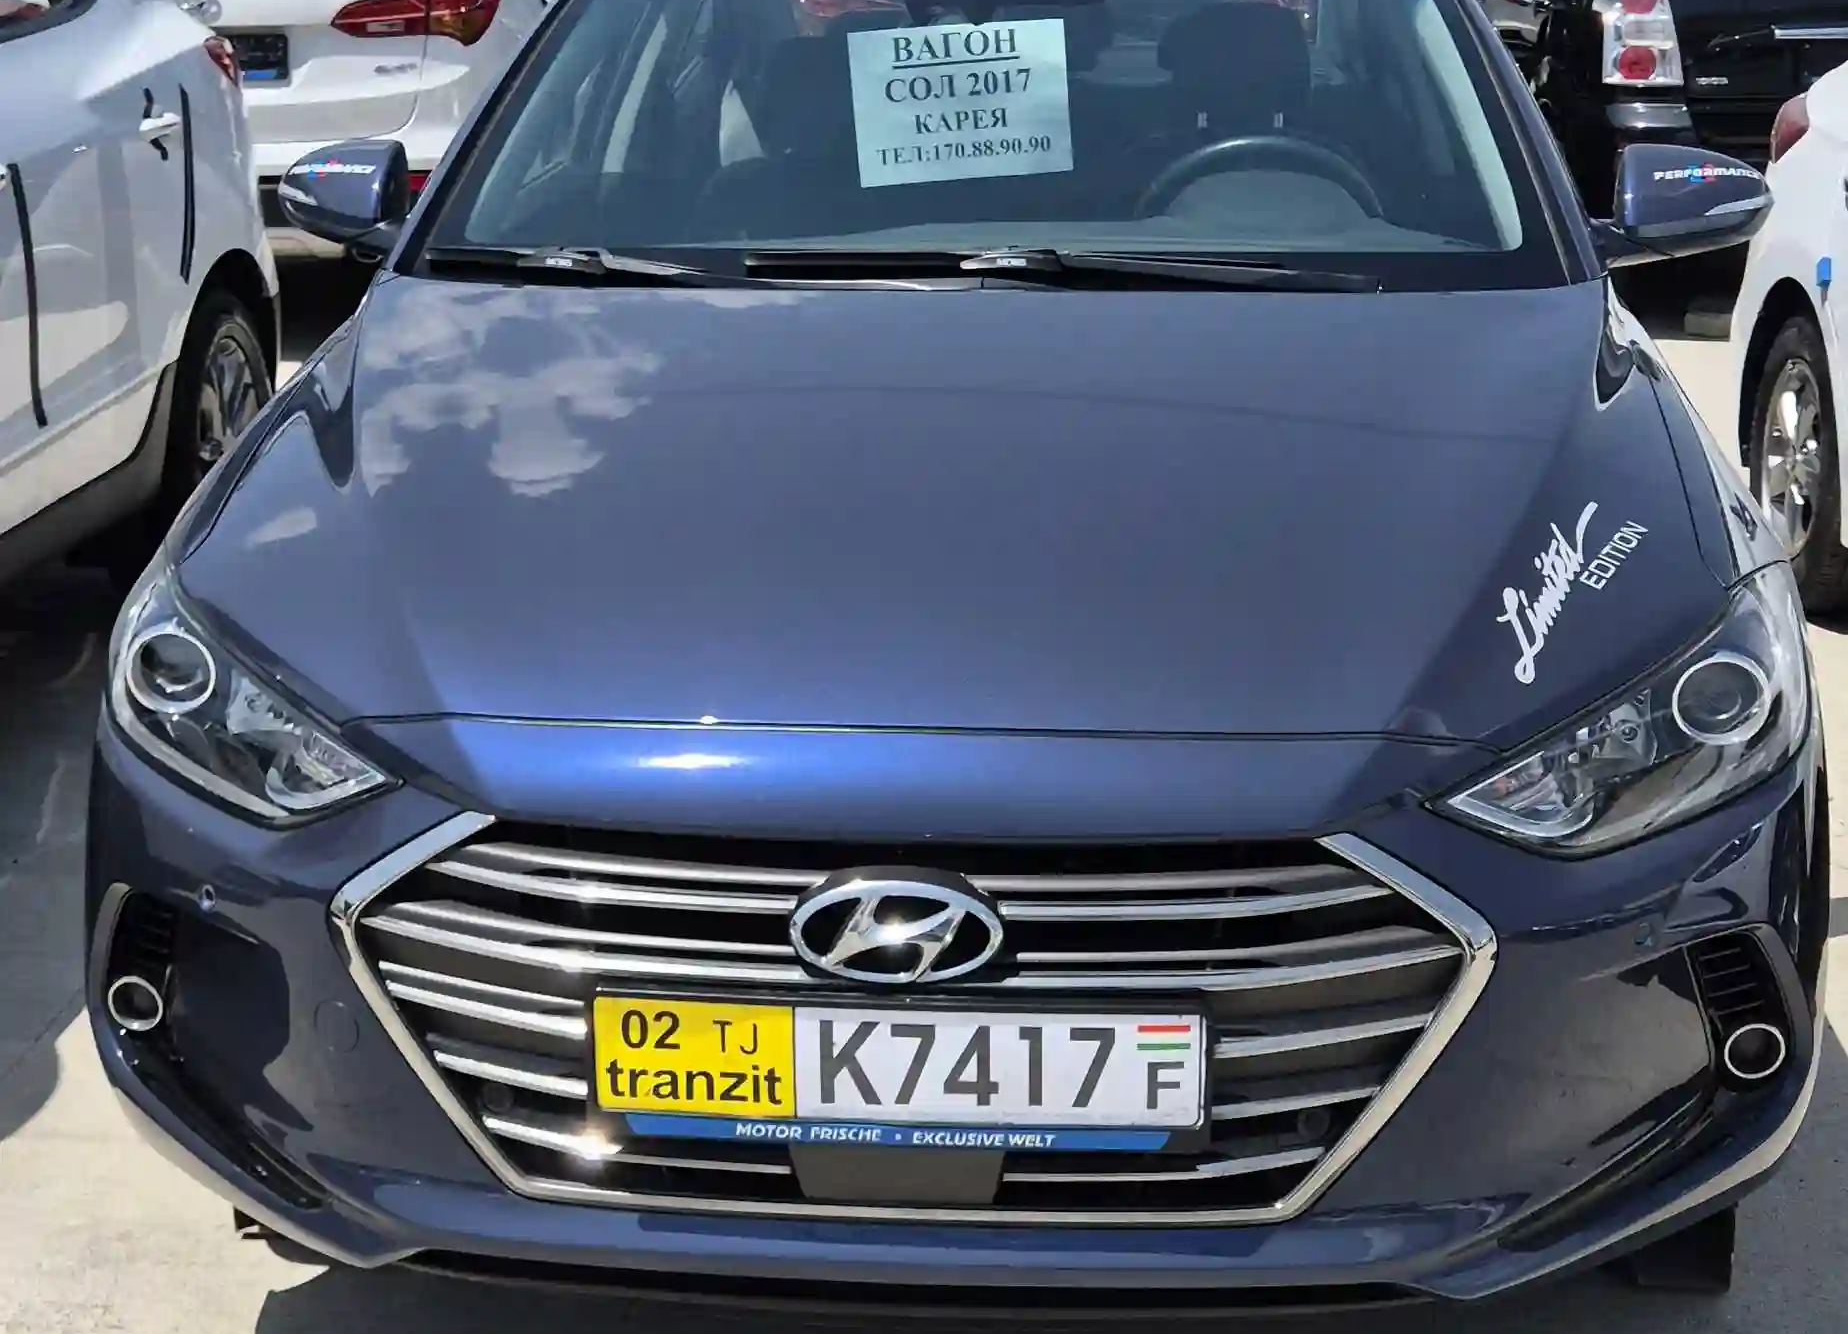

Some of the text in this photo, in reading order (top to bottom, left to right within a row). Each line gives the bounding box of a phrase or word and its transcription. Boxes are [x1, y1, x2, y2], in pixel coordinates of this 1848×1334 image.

[892, 28, 1018, 64] ВАГОН
[885, 68, 1031, 103] СОЛ 2017
[914, 107, 1009, 135] КАРЕЯ
[1579, 520, 1650, 591] EDITION
[1496, 501, 1599, 685] Limited
[621, 1009, 758, 1055] 02 TJ
[606, 1058, 782, 1106] tranzit
[819, 1019, 1116, 1108] K7417
[1146, 1061, 1185, 1110] F
[736, 1122, 1057, 1148] MOTOR FRISCHE EXCLUSIVE WELT
